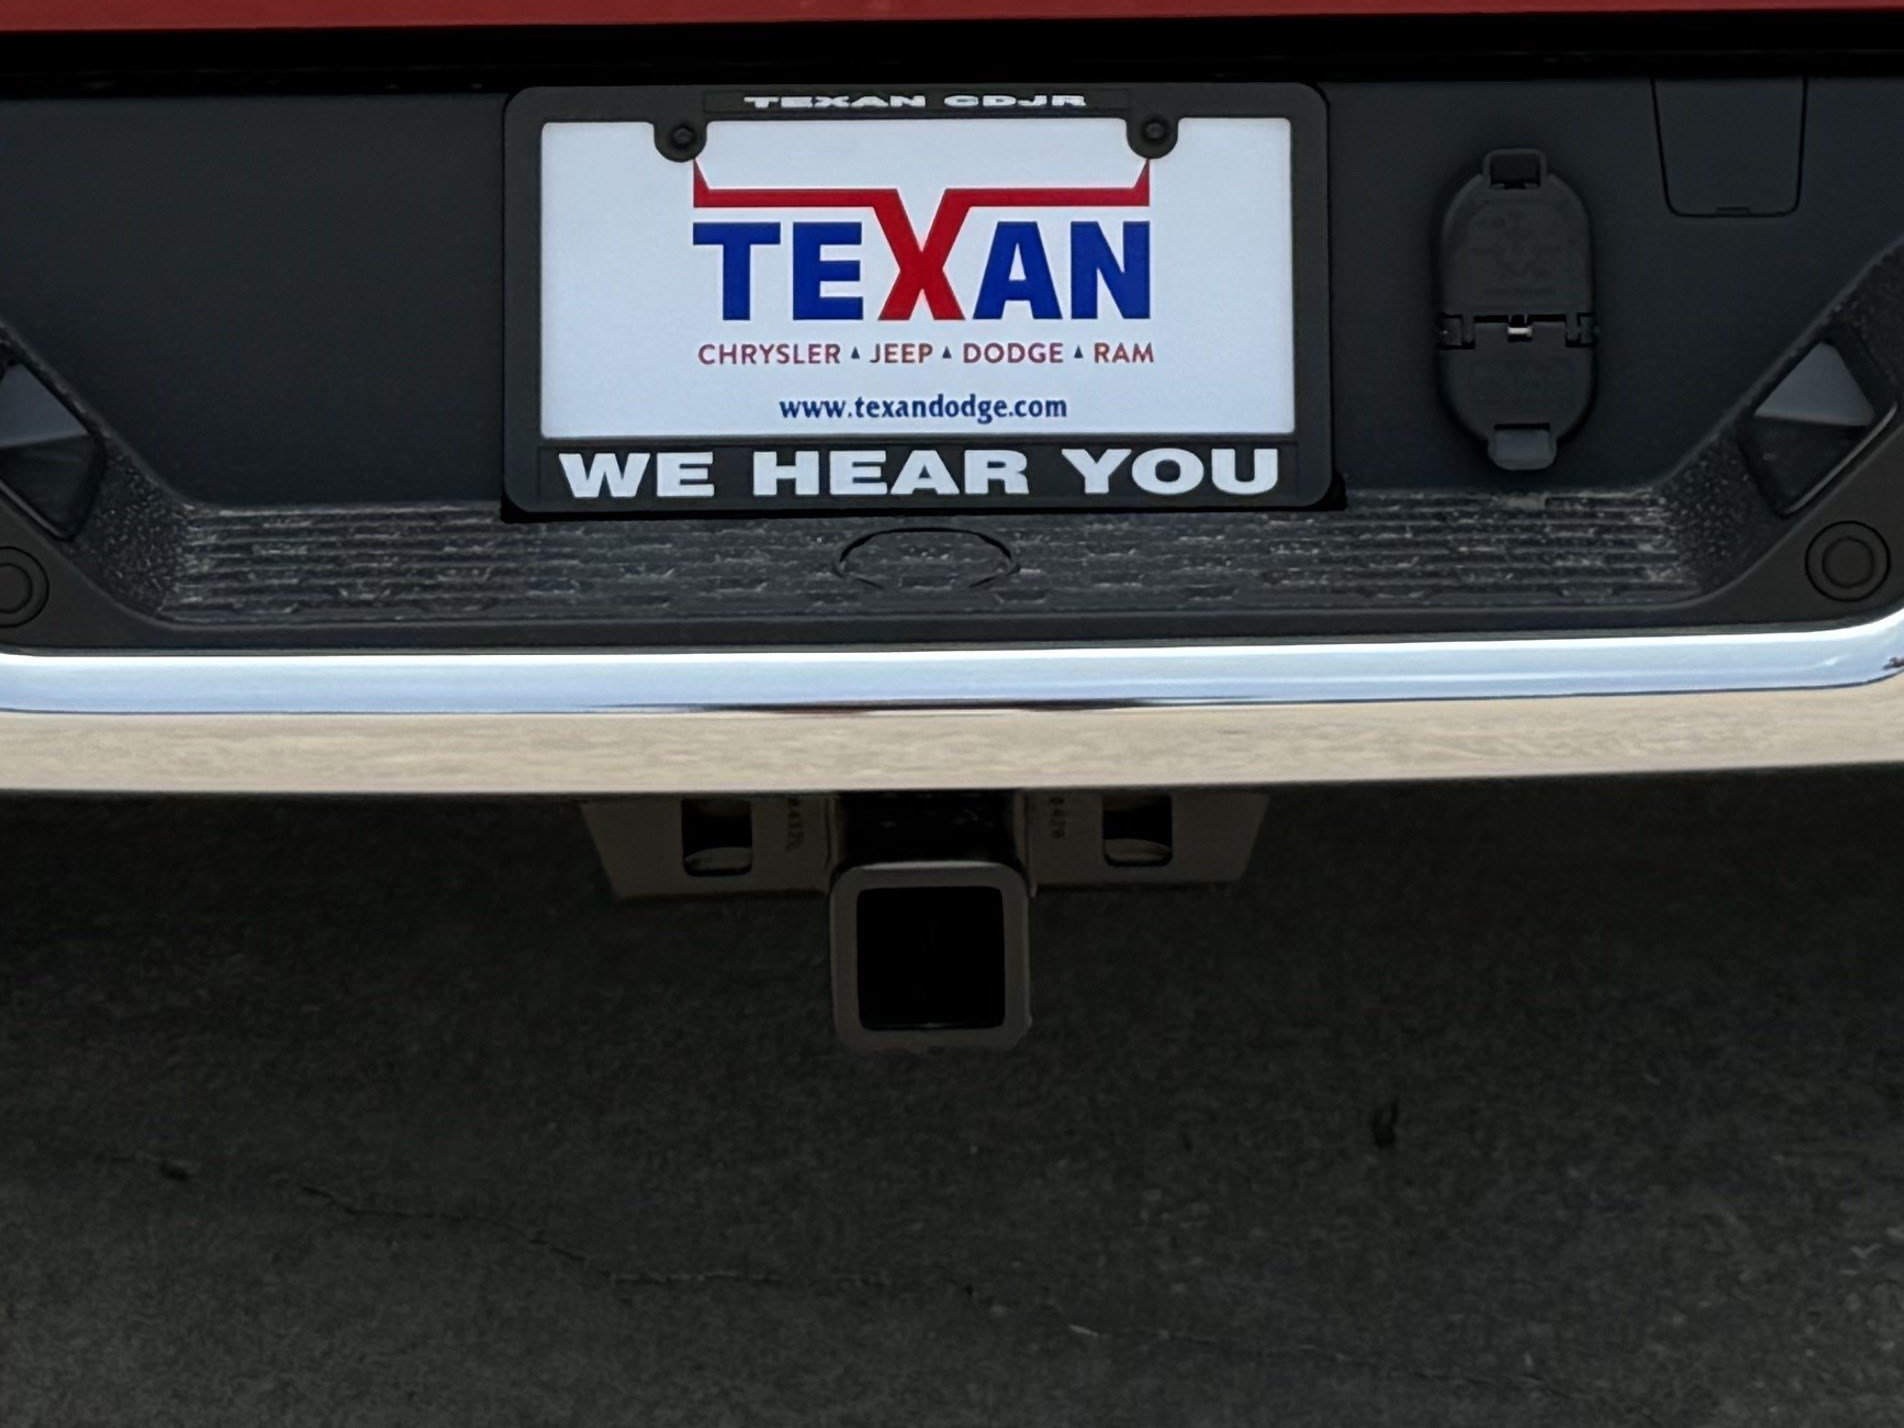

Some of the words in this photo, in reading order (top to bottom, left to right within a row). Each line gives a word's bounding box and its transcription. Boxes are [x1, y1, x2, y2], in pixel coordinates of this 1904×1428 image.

[743, 94, 926, 109] TEXAN
[943, 94, 1087, 108] CDJR
[693, 184, 1151, 321] TEXAN
[698, 343, 842, 366] CHRYSLER
[870, 343, 934, 365] JEEP
[962, 343, 1064, 365] DODGE
[1093, 343, 1156, 365] RAM
[778, 393, 1068, 425] www.texandodge.com
[558, 451, 715, 499] WE
[751, 449, 1030, 497] HEAR
[1061, 446, 1280, 496] YOU
